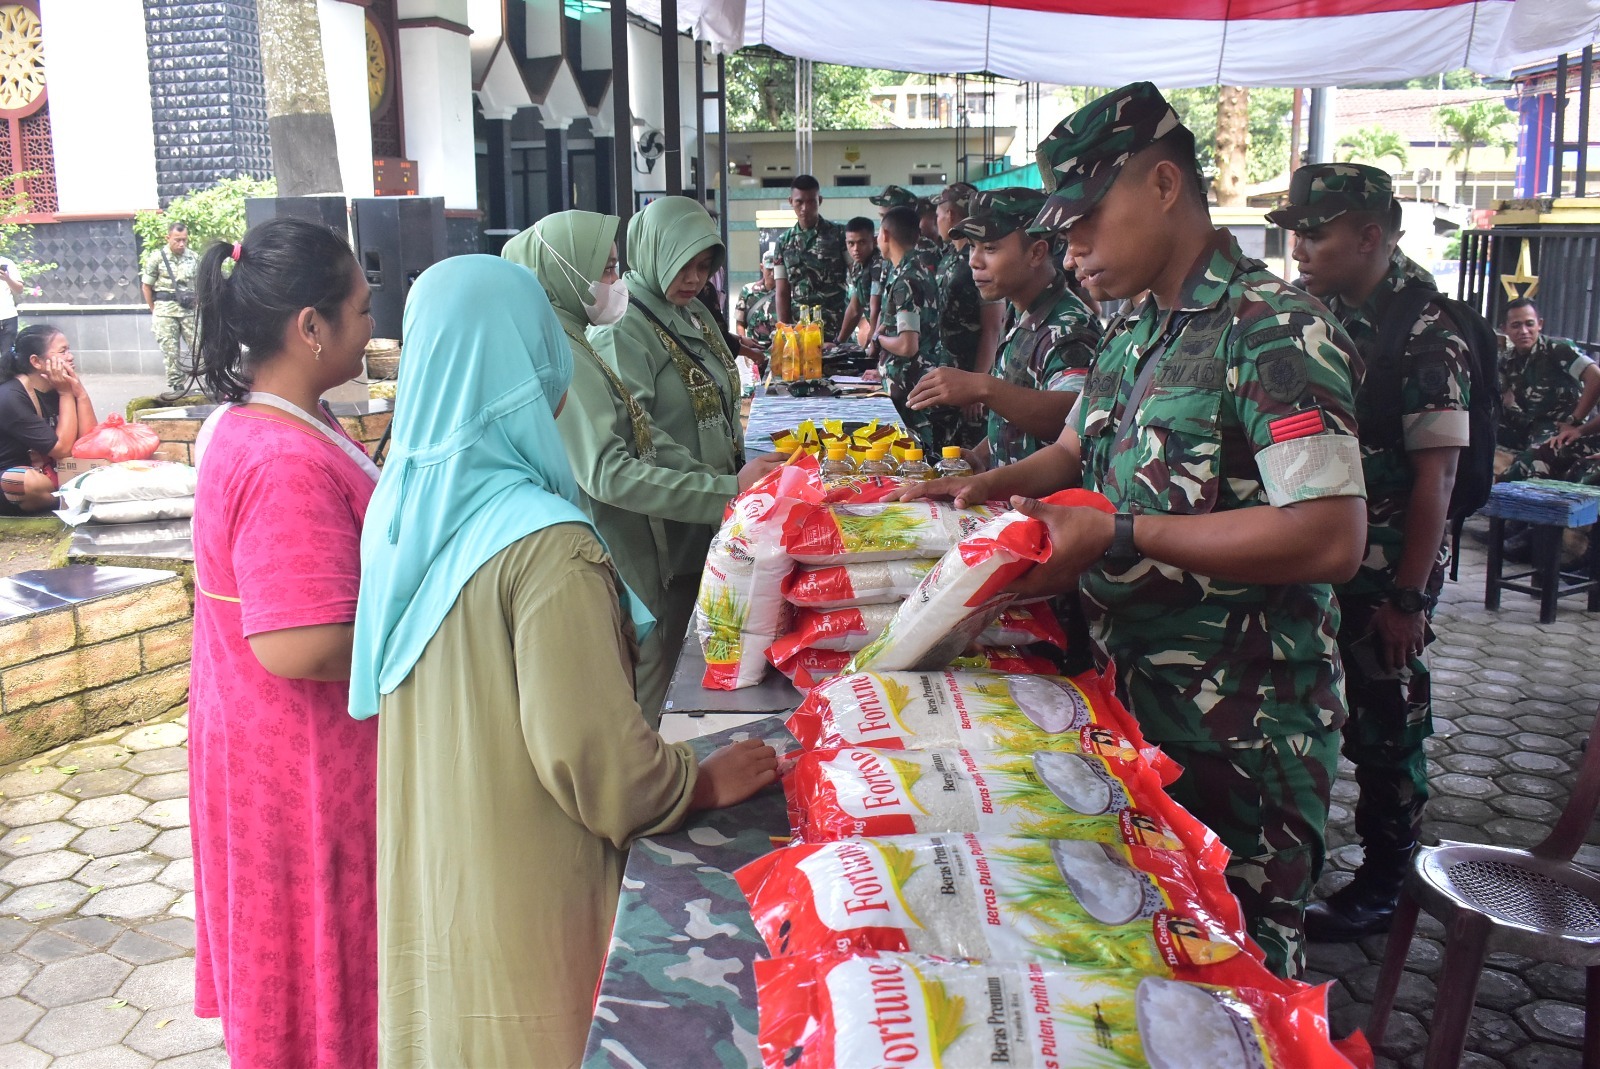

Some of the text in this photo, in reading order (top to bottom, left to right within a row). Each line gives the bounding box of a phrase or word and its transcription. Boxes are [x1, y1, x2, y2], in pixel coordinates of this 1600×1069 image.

[1159, 365, 1186, 383] TNI
[849, 675, 891, 735] Fortune
[920, 675, 939, 715] Beras Premium
[961, 710, 972, 730] Beras
[943, 773, 956, 792] Beras
[982, 788, 994, 814] Beras
[965, 839, 984, 857] Putih
[941, 866, 955, 895] Beras
[975, 858, 993, 887] Pulen,
[984, 888, 1001, 926] Beras
[1158, 913, 1178, 966] Ibu CerMat
[1030, 986, 1051, 1014] Putih
[868, 964, 919, 1069] ortune
[984, 976, 1009, 1064] Beras Premium
[1038, 1017, 1058, 1057] Pulen,
